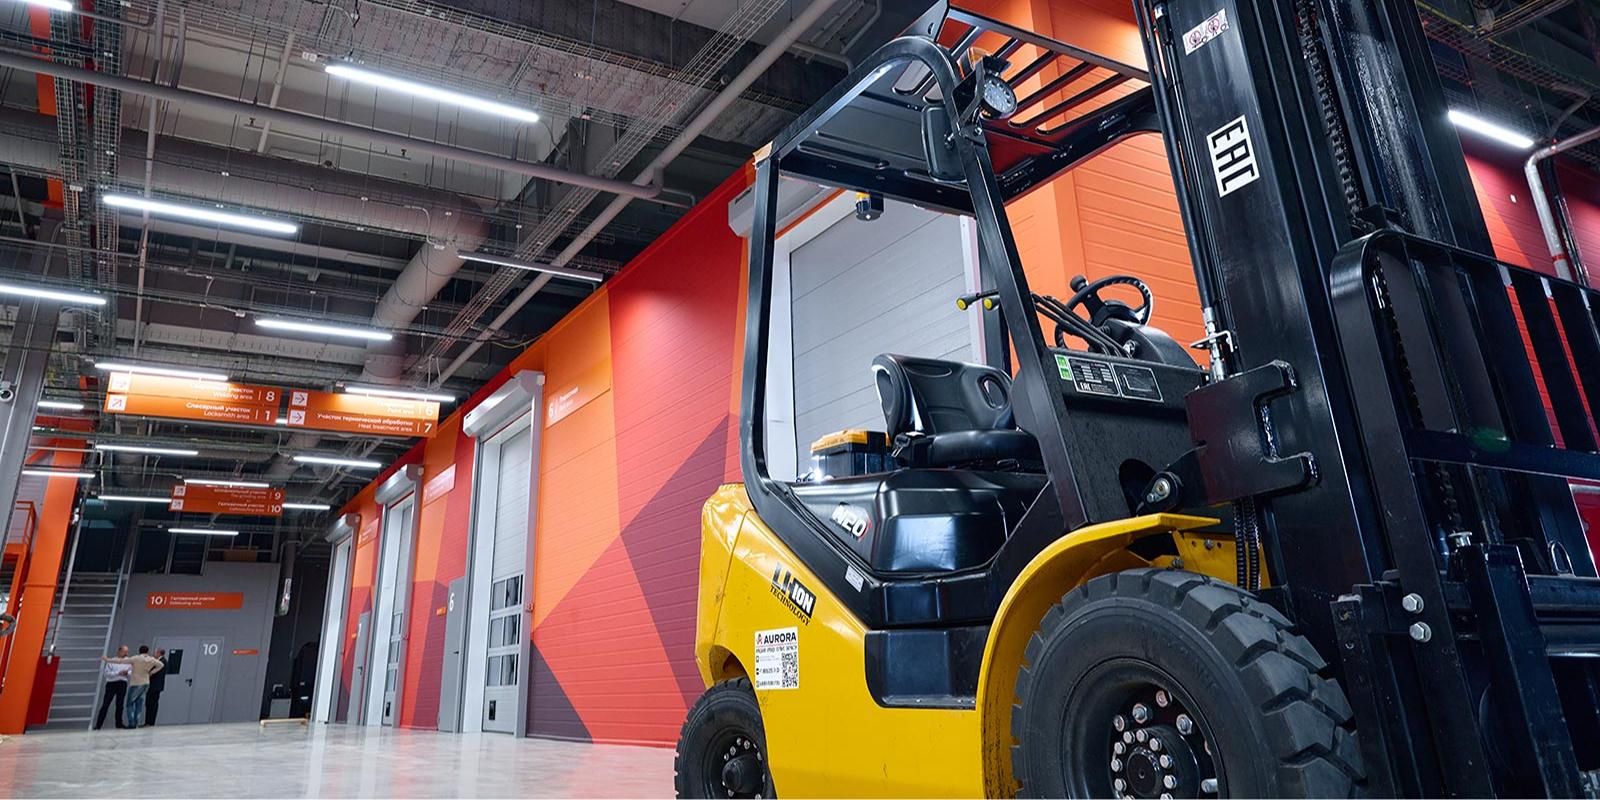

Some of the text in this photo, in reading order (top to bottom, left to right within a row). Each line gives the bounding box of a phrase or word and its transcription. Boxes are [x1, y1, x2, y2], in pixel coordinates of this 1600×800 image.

[1210, 119, 1256, 193] EAC
[265, 390, 275, 402] 8
[225, 406, 251, 414] участок
[265, 410, 271, 422] 1
[425, 405, 433, 417] 6
[317, 413, 342, 421] Участок
[424, 422, 433, 433] 7
[274, 491, 281, 500] 9
[271, 504, 282, 514] 10
[151, 595, 163, 606] 10
[449, 591, 455, 612] 6
[770, 585, 811, 627] TECHNOLOGY
[763, 631, 797, 645] AURORA
[202, 643, 219, 656] 10
